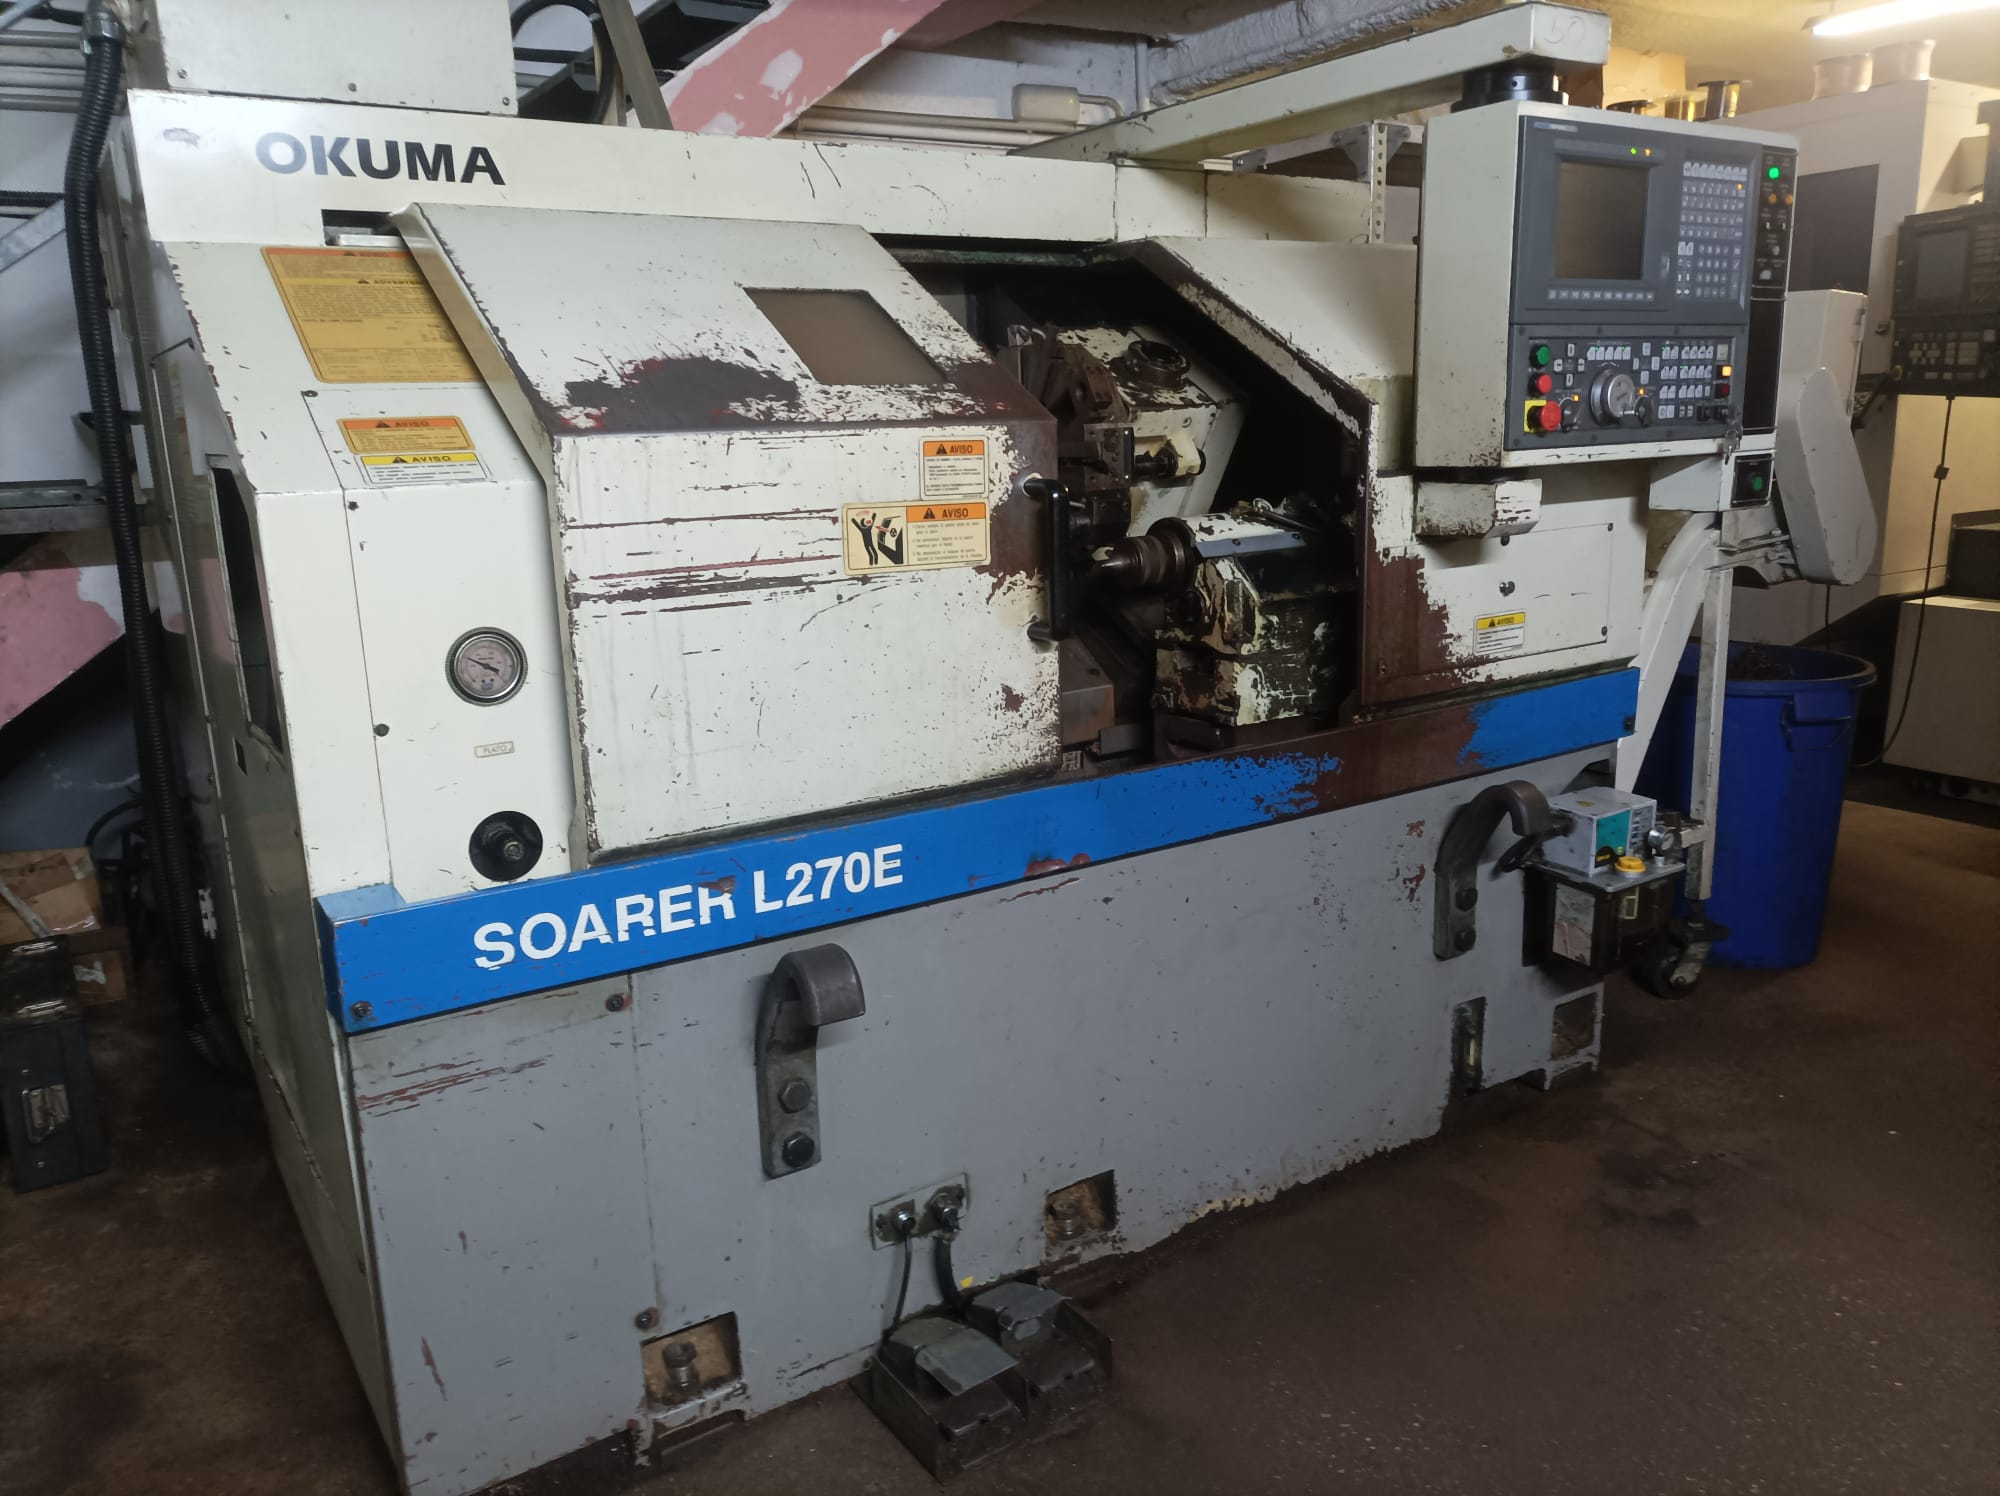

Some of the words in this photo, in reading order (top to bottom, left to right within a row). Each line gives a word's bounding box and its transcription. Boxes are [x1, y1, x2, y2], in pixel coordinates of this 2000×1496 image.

[255, 131, 506, 186] OKUMA
[949, 444, 973, 454] AVISO
[412, 455, 452, 463] AVISO
[942, 508, 969, 519] AVISO
[473, 883, 736, 971] SOARER
[753, 842, 904, 914] L270E
